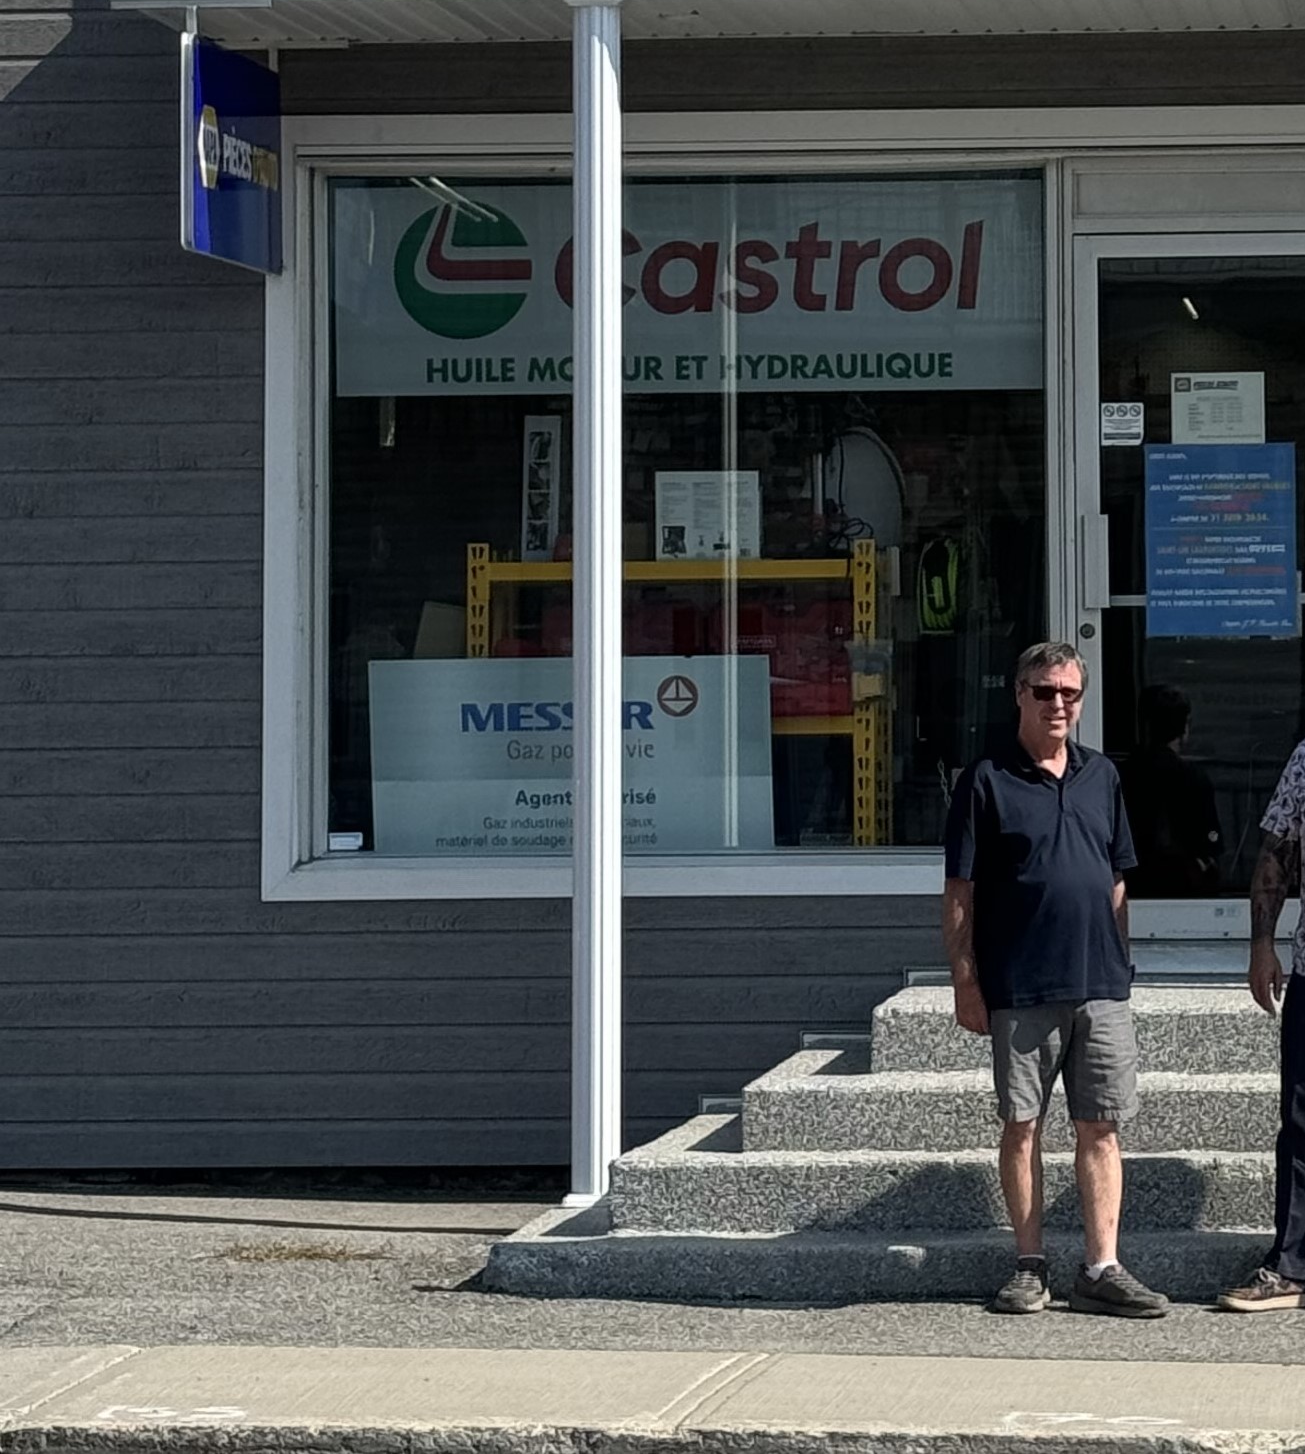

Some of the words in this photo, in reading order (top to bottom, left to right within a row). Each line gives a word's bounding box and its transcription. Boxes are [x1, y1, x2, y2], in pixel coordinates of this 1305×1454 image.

[426, 357, 516, 384] HUILE
[527, 356, 665, 383] MOUR
[675, 355, 709, 381] ET
[720, 352, 954, 381] HYDRAULIQUE
[460, 700, 655, 733] MESR
[506, 740, 543, 761] Gaz
[626, 739, 655, 760] vie
[514, 790, 573, 810] Agent
[482, 816, 507, 830] Gaz
